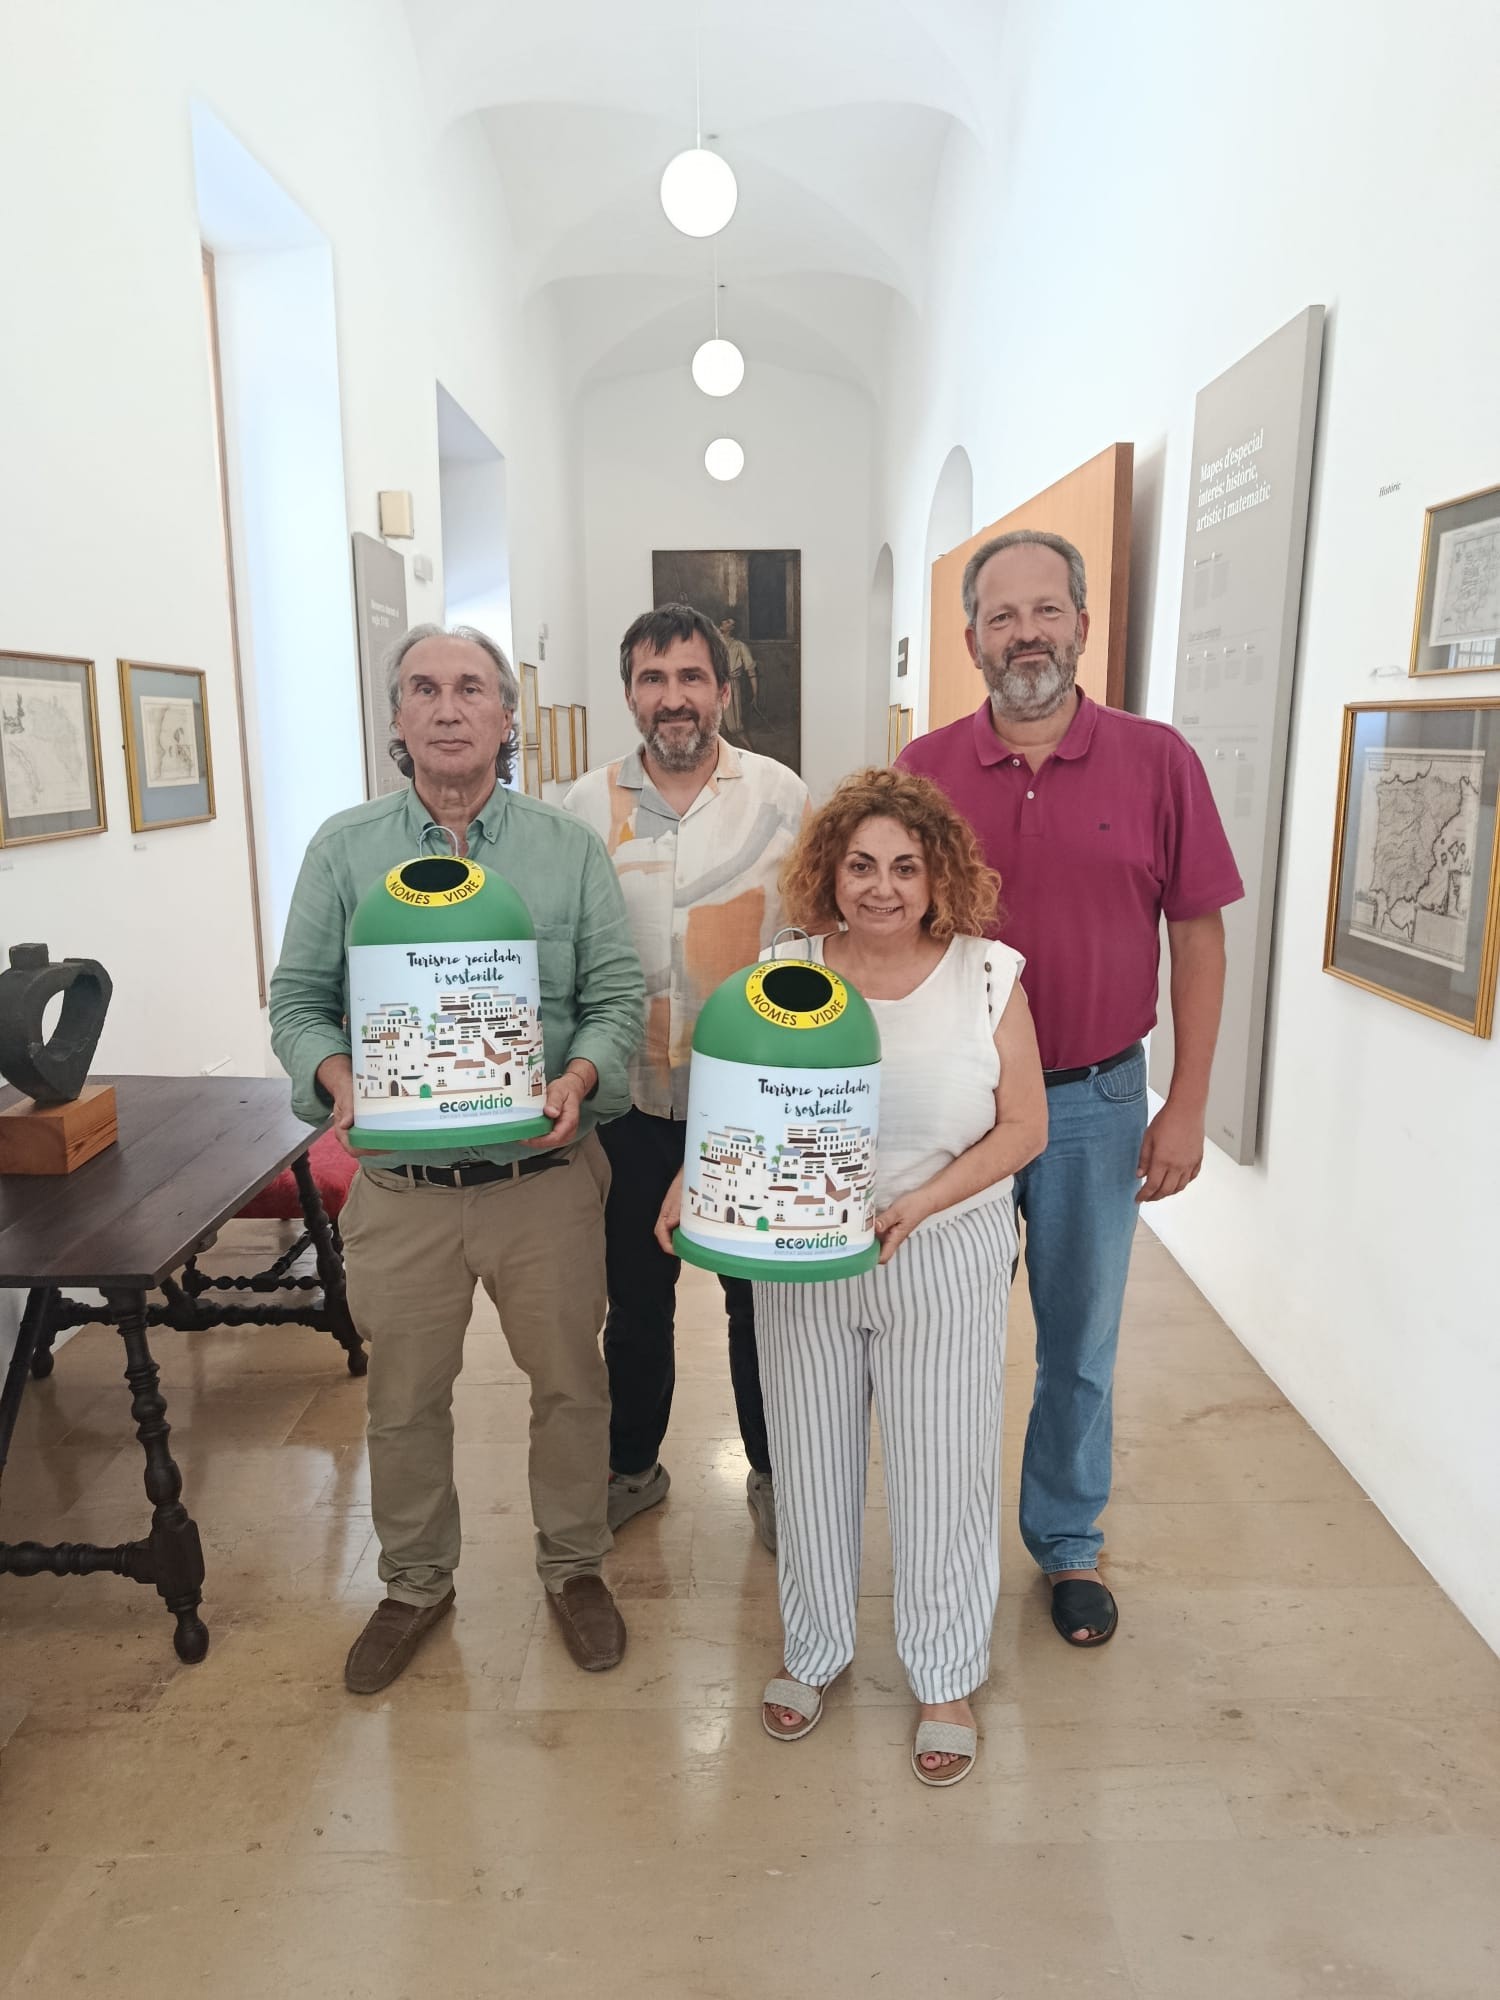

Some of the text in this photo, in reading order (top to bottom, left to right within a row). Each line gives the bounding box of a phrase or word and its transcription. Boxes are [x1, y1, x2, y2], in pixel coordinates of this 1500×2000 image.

[1200, 457, 1223, 482] Mapes
[443, 880, 480, 903] VIDRE
[406, 951, 461, 968] Turismo
[434, 972, 442, 984] i
[810, 999, 844, 1025] VIDRE
[758, 1078, 813, 1097] Turismo
[439, 1093, 513, 1113] ecovidrio
[784, 1103, 792, 1115] i
[775, 1231, 848, 1250] ecovidrio
